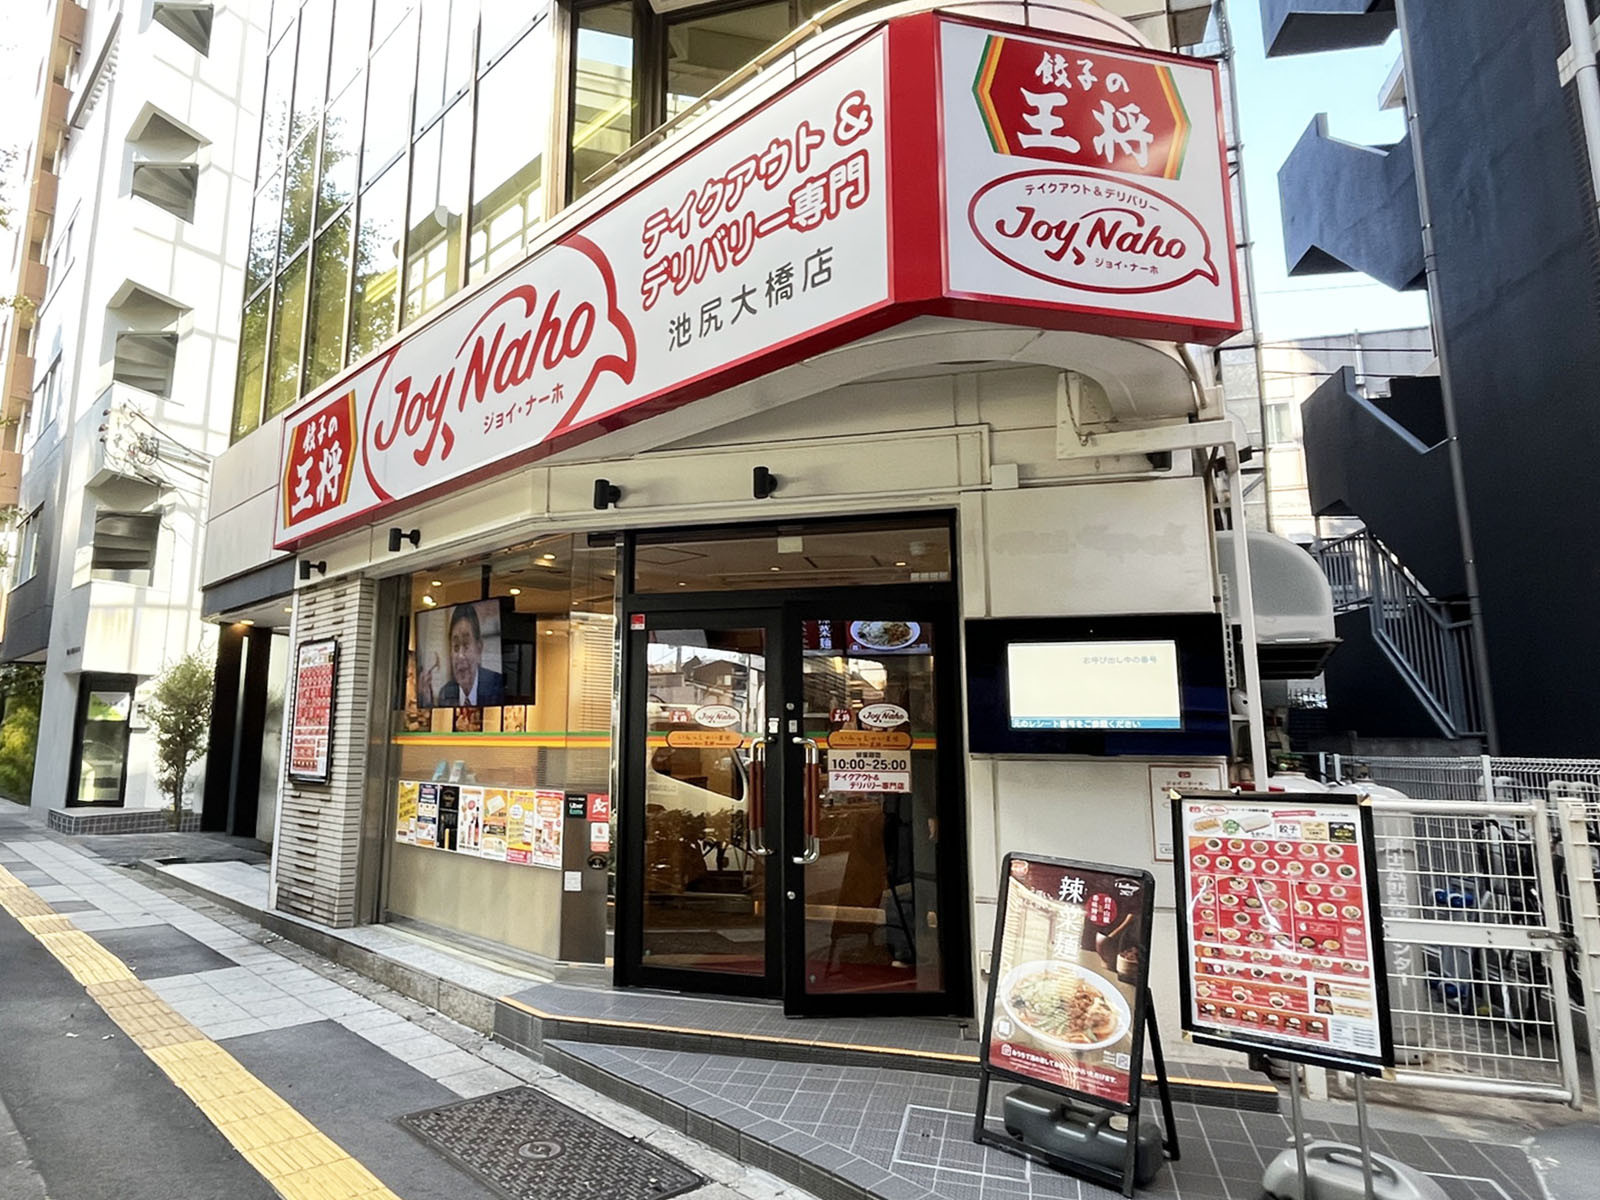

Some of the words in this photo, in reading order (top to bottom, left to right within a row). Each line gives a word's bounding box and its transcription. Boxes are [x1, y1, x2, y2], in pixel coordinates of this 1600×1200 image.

[1035, 51, 1130, 94] 餃子の
[1017, 87, 1154, 169] 王将
[640, 148, 871, 312] デリバリー専門
[995, 205, 1082, 264] Joy
[1083, 206, 1187, 260] Naho
[668, 245, 834, 353] 池尻大橋店
[374, 366, 456, 467] Joy
[456, 285, 597, 413] Naho
[302, 413, 339, 455] 餃子の
[291, 440, 343, 519] 王将
